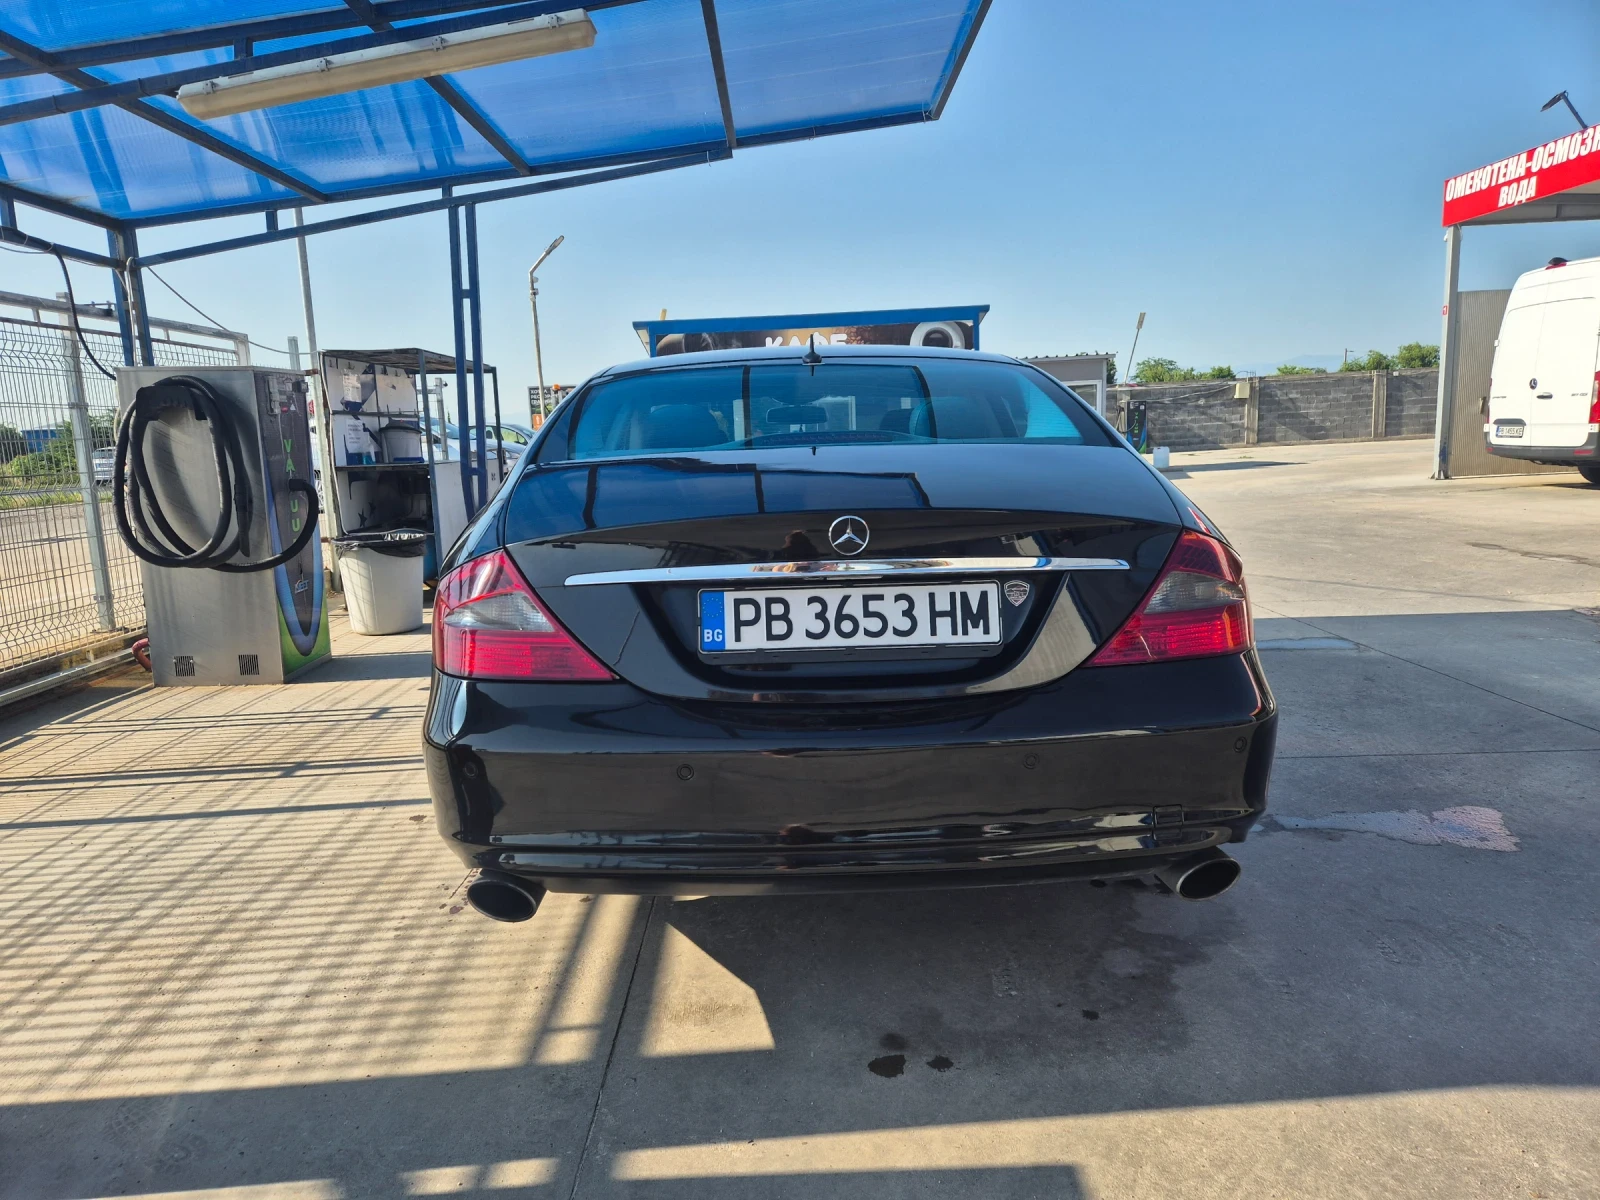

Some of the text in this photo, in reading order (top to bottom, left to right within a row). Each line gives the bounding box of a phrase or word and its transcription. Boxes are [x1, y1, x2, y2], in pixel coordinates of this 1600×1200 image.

[1498, 176, 1537, 207] ВОДА
[284, 439, 300, 543] VAUU
[703, 629, 723, 642] BG
[733, 597, 794, 643] PB
[805, 594, 918, 640] 3653
[928, 590, 990, 637] HM
